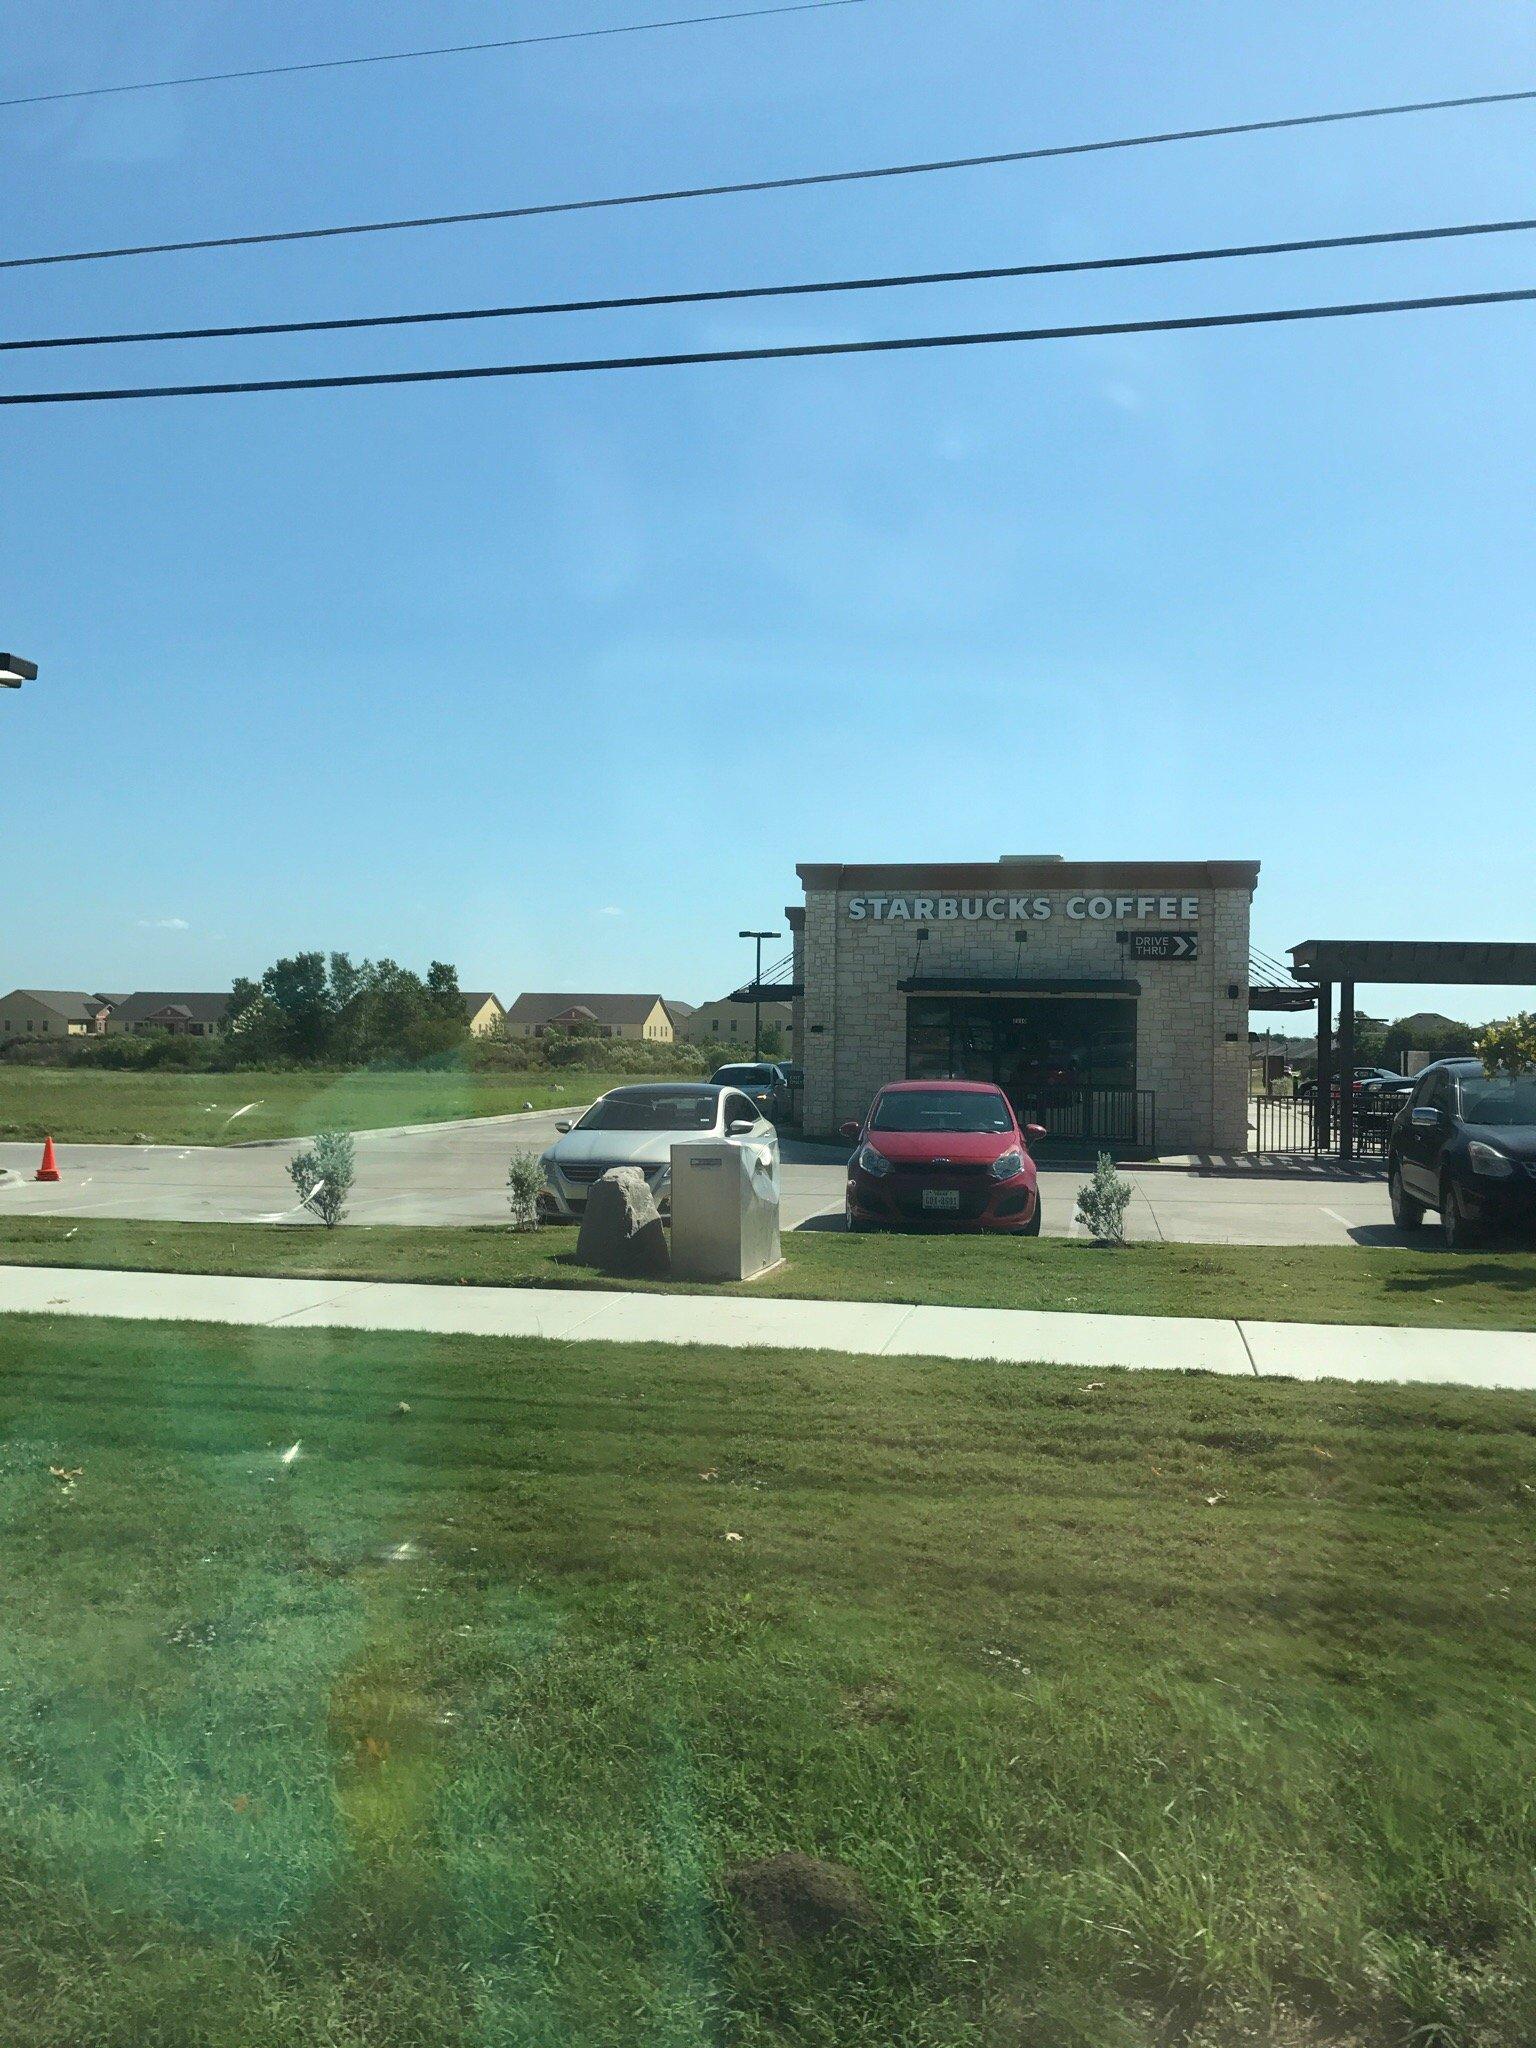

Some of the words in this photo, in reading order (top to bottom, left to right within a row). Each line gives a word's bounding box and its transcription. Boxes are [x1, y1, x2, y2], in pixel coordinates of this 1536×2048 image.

[848, 897, 1051, 920] STARBUCKS
[1066, 896, 1200, 920] COFFEE
[1135, 936, 1169, 946] DRIVE
[1135, 946, 1167, 955] THRU
